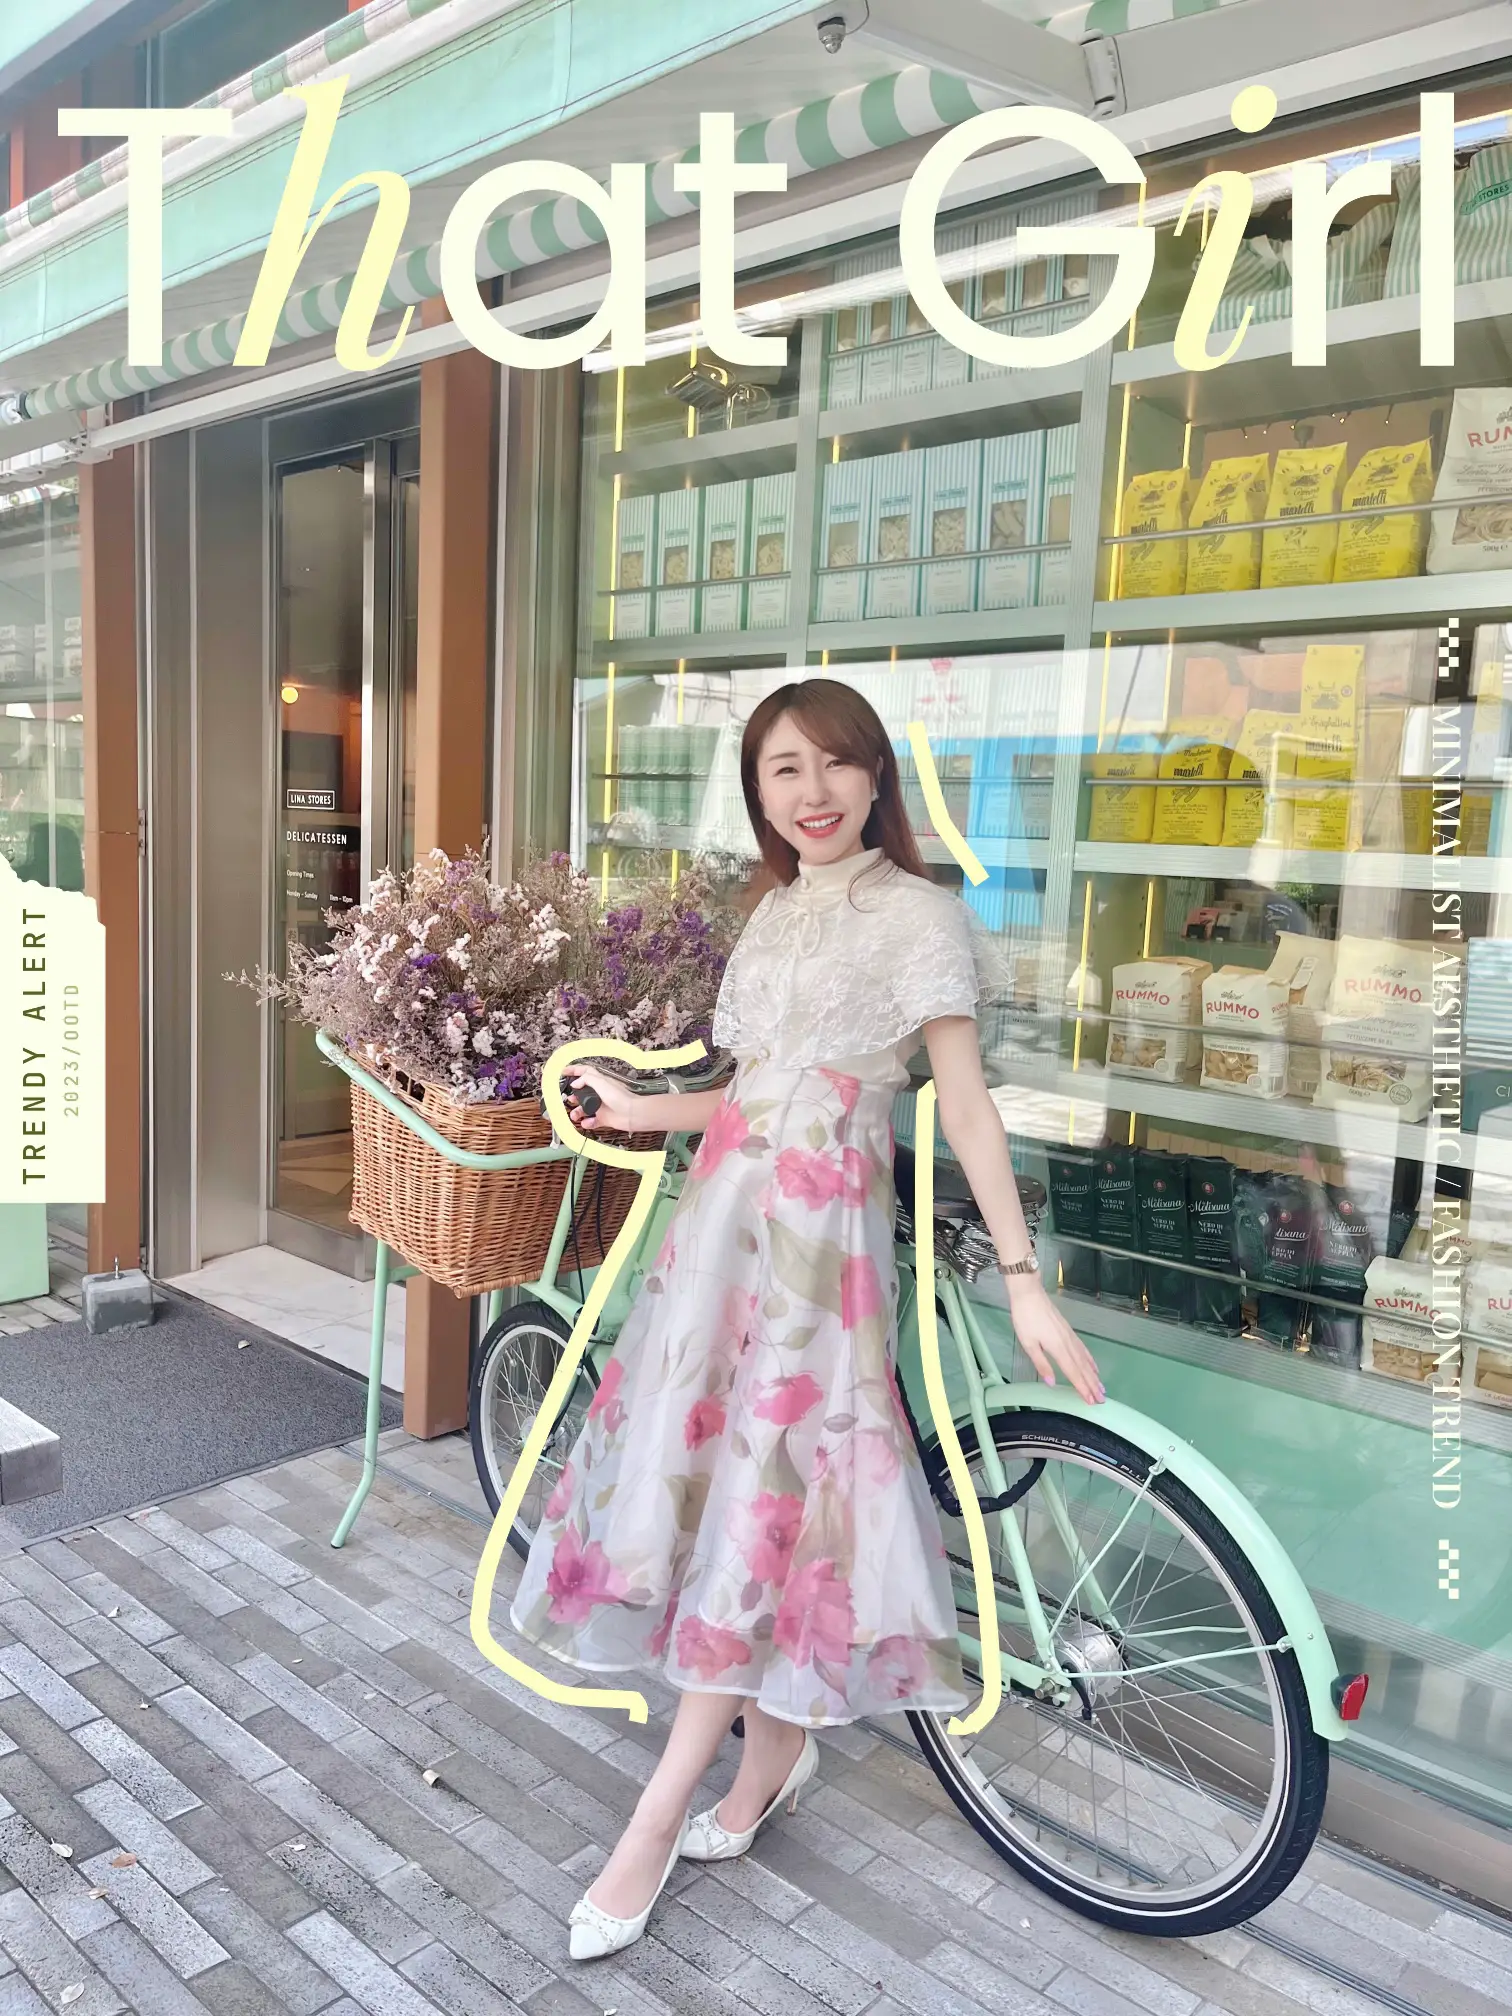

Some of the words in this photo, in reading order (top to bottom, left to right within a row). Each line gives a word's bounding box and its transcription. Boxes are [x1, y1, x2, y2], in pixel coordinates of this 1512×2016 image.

[290, 795, 305, 804] LINA
[307, 795, 331, 805] STORES
[286, 830, 347, 845] DELICATESSEN
[1116, 989, 1170, 1006] RUMMO
[1344, 977, 1422, 1004] RUMMO
[1206, 1001, 1260, 1019] RUMMO
[1021, 1434, 1077, 1448] SCHWALBE
